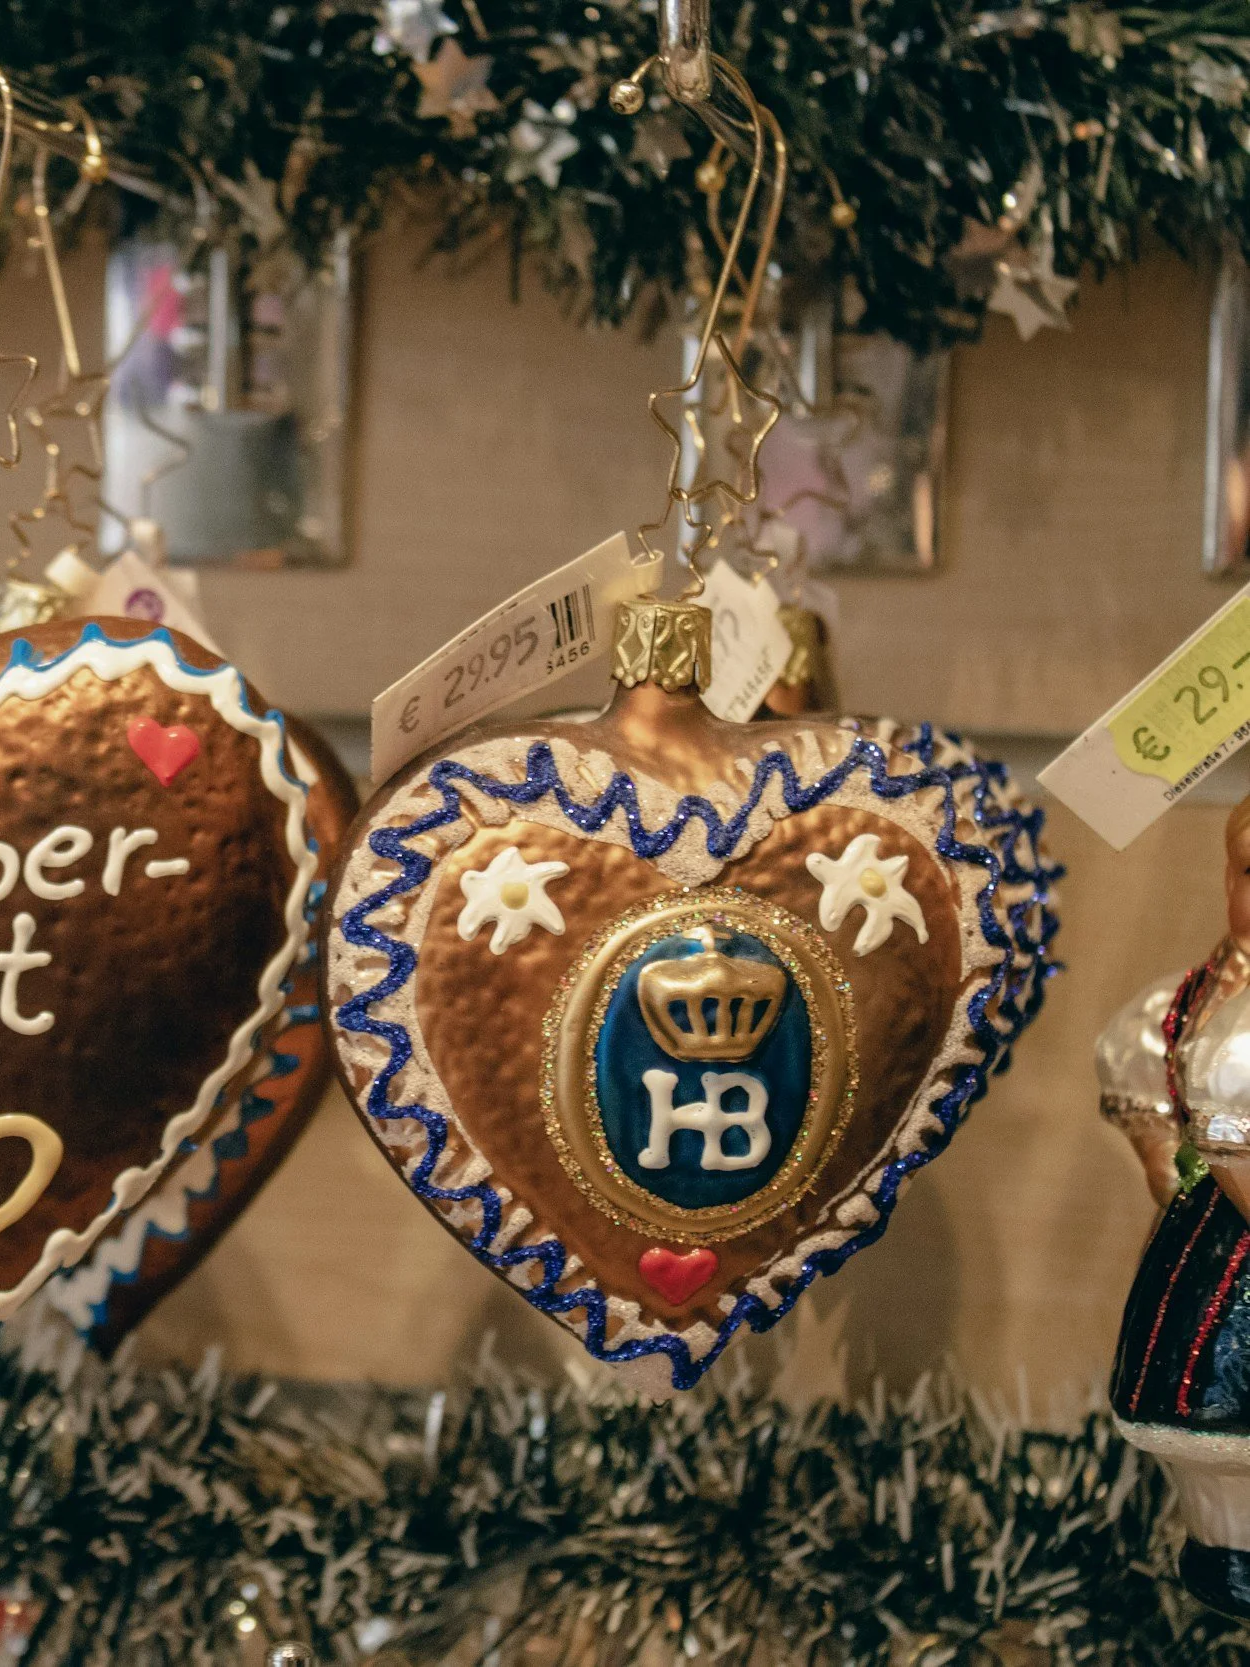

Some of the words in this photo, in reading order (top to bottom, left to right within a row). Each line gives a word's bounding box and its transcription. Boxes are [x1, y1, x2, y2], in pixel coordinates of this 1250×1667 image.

[398, 695, 421, 734] €
[443, 615, 539, 709] 29.95
[1132, 726, 1171, 762] €
[1163, 752, 1222, 801] Dieselstraße
[637, 1069, 772, 1171] HB
